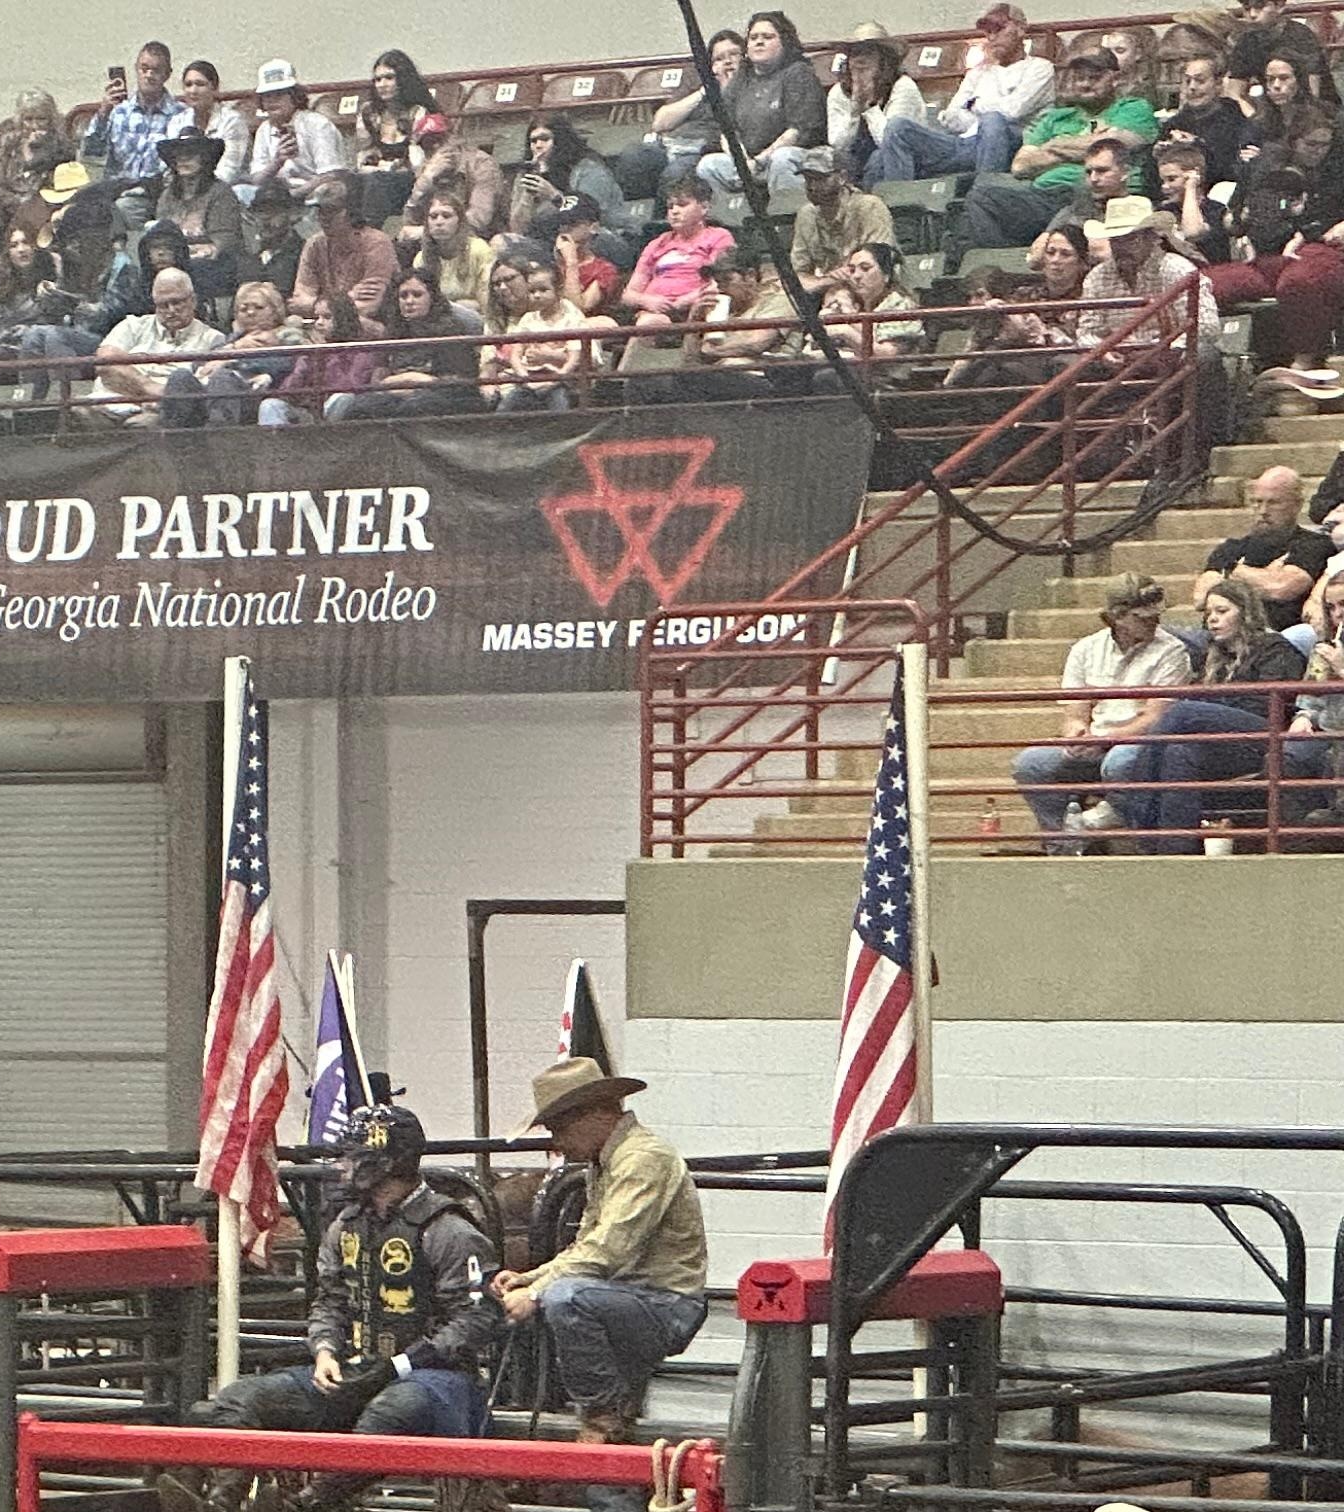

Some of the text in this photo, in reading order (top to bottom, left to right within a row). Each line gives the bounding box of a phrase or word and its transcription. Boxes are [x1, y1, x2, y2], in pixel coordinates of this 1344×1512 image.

[116, 486, 434, 560] PARTNER
[129, 573, 307, 628] National
[314, 570, 437, 625] Rodeo
[482, 620, 617, 651] MASSEY
